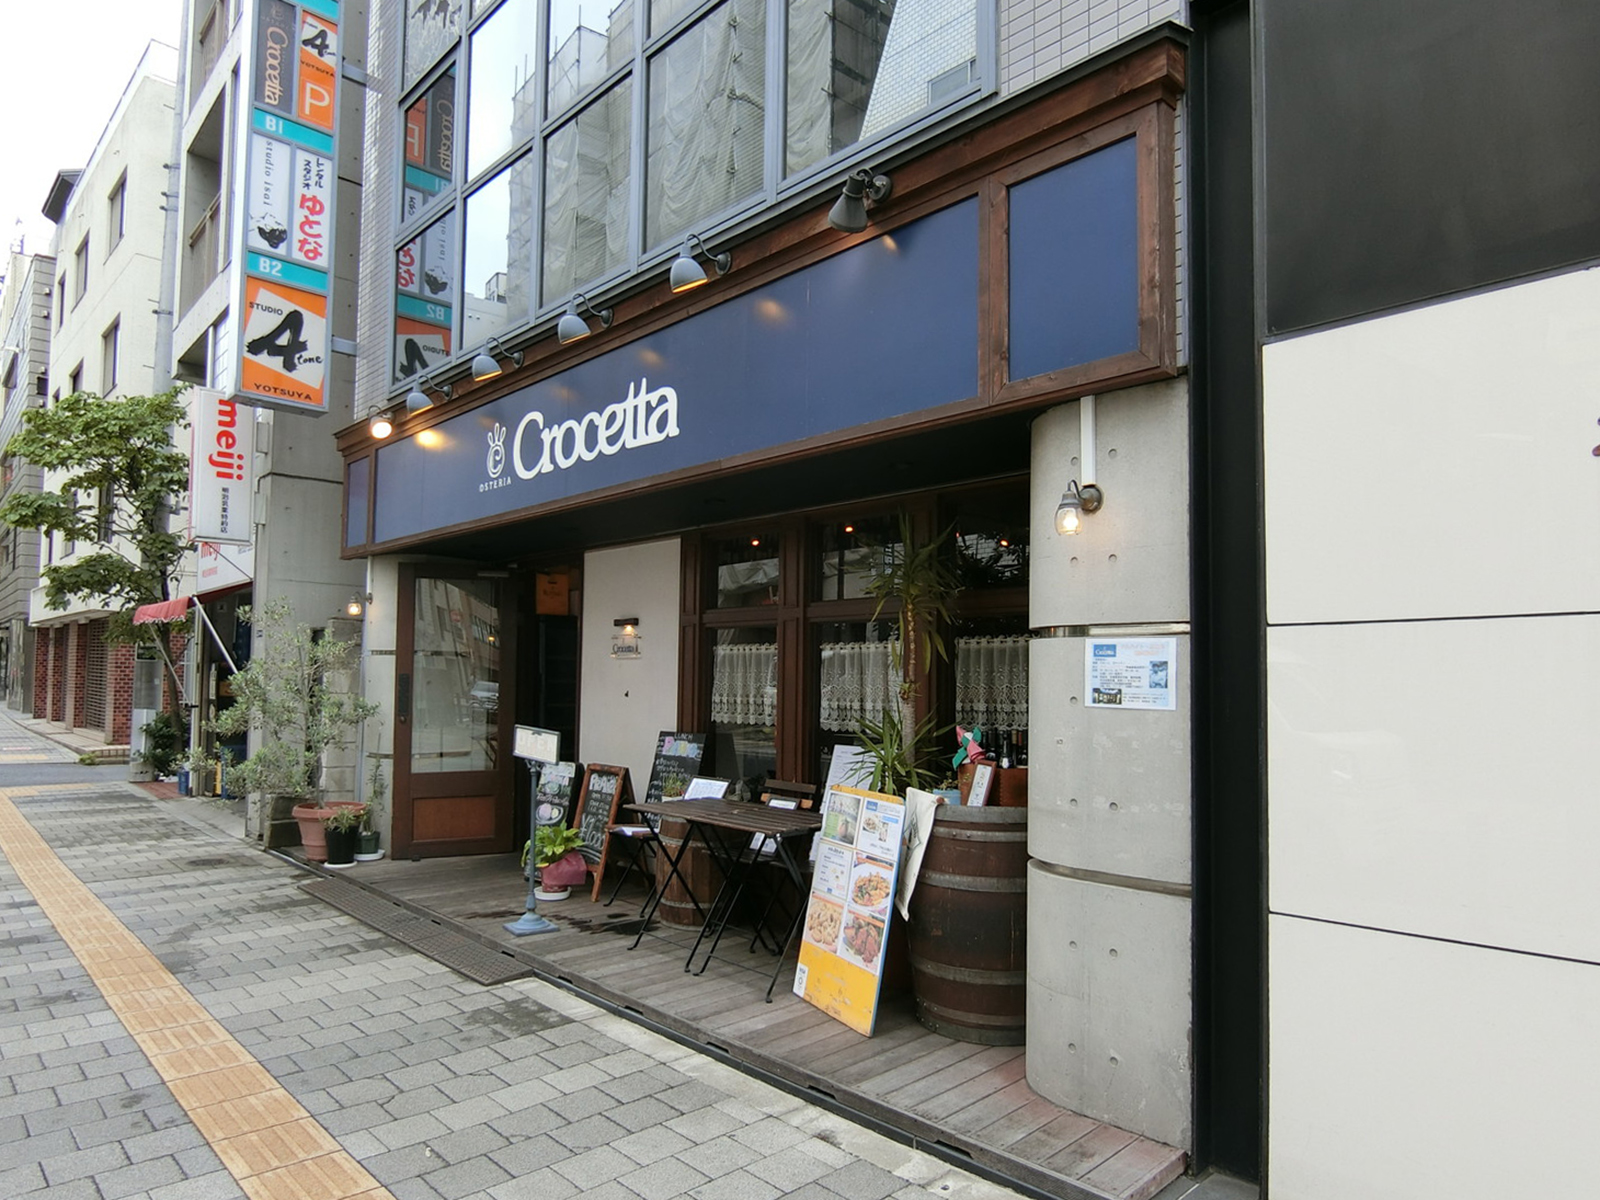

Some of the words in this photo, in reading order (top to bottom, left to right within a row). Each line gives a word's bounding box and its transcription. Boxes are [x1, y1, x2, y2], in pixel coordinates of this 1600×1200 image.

[265, 27, 288, 105] Crocetta
[304, 82, 330, 115] P
[265, 115, 283, 134] B1
[264, 140, 275, 177] studio
[315, 158, 325, 189] レンタル
[302, 159, 312, 190] スタジオ
[298, 193, 325, 261] ゆとな
[259, 258, 282, 276] B2
[249, 302, 283, 316] STUDIO
[253, 383, 312, 401] YOTSUYA
[208, 399, 244, 481] meiji
[513, 377, 680, 480] Crocetta
[479, 476, 512, 493] OSTERIA
